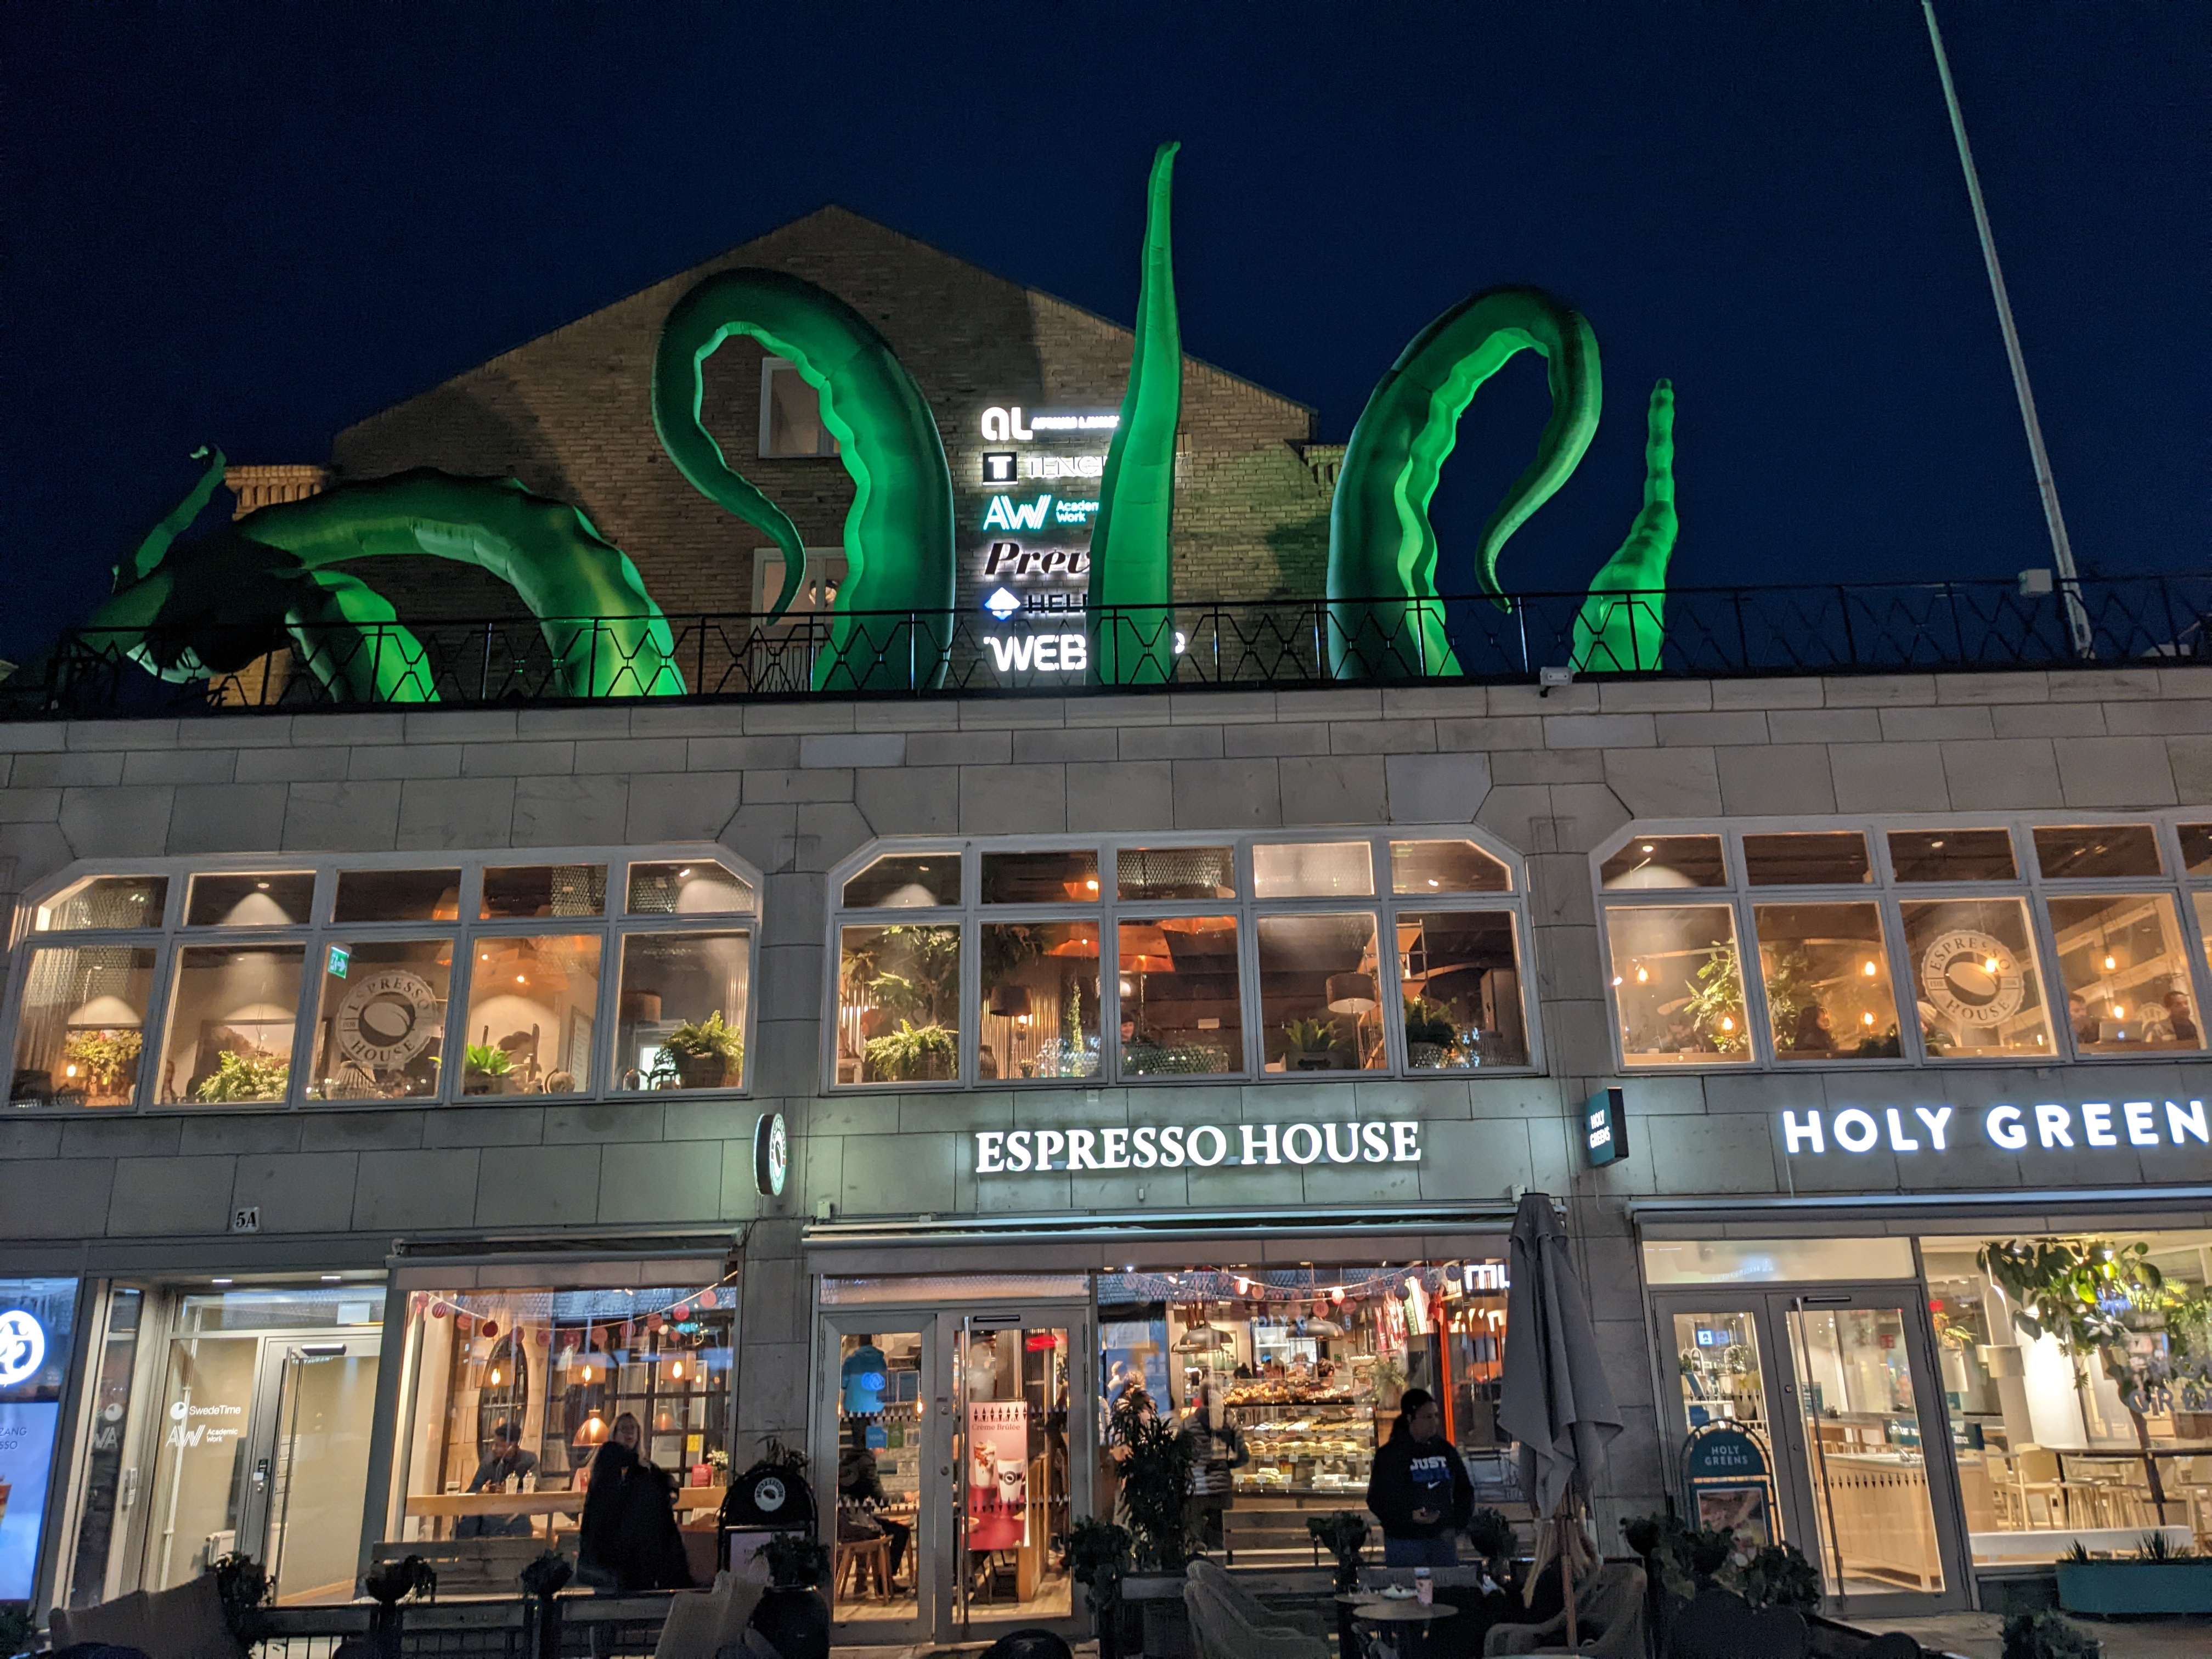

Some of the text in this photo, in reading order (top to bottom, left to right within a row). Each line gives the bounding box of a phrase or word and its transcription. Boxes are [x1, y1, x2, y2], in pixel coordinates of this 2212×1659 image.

[1056, 511, 1086, 523] Work
[1946, 999, 2010, 1021] HOUSE
[351, 1039, 415, 1062] HOUSE
[1590, 1109, 1605, 1130] HOLY
[1782, 1107, 1953, 1153] HOLY
[975, 1121, 1423, 1173] ESPRESSO HOUSE
[1590, 1126, 1611, 1148] GREENS
[236, 1211, 257, 1228] 5A
[189, 1405, 241, 1415] SwedeTime
[166, 1424, 206, 1447] AW
[1705, 1454, 1748, 1466] GREENS
[1711, 1445, 1740, 1455] HOLY
[1409, 1455, 1447, 1471] JUST
